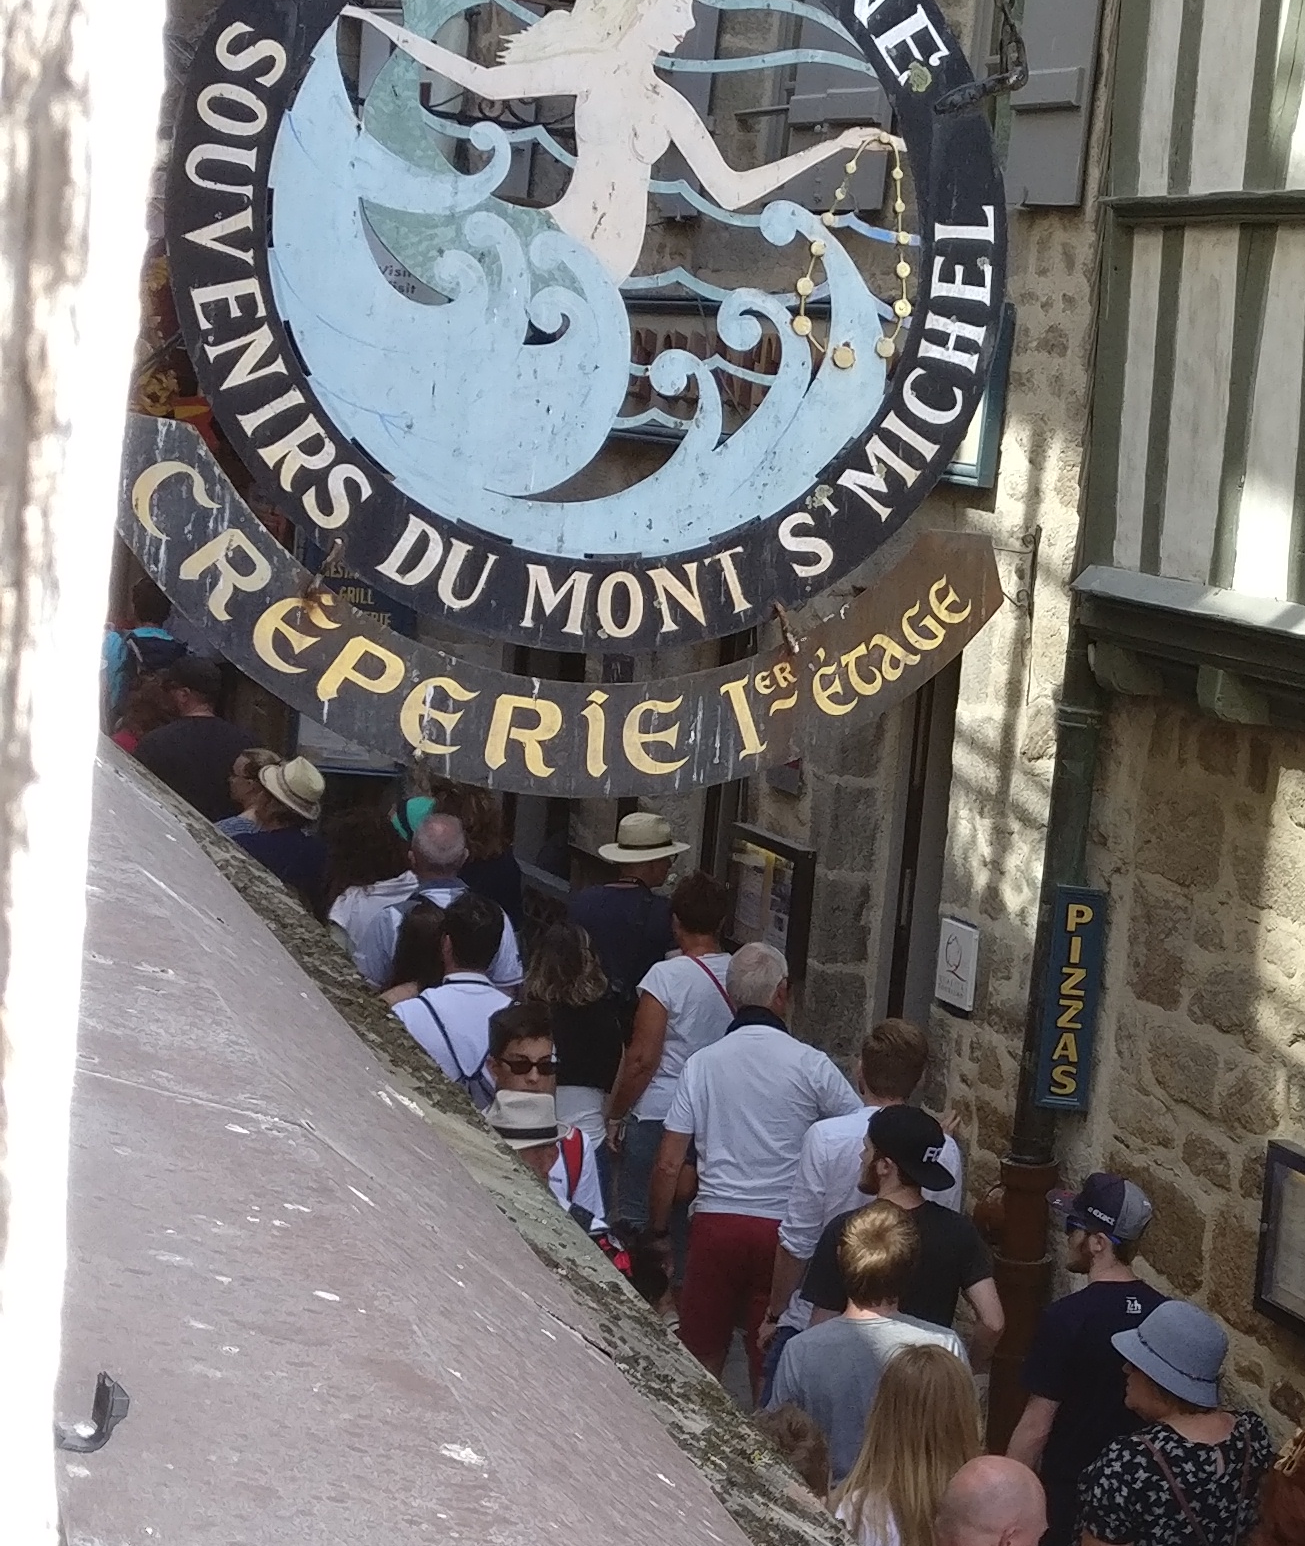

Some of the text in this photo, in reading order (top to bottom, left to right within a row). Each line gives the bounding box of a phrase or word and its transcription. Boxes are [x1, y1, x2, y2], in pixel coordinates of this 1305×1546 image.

[184, 20, 373, 530] SOUVENIRS
[374, 513, 497, 609] DU
[520, 544, 752, 637] MONT
[837, 204, 996, 522] MICHEL
[340, 586, 375, 605] GRILL
[1049, 903, 1094, 1095] PIZZAS
